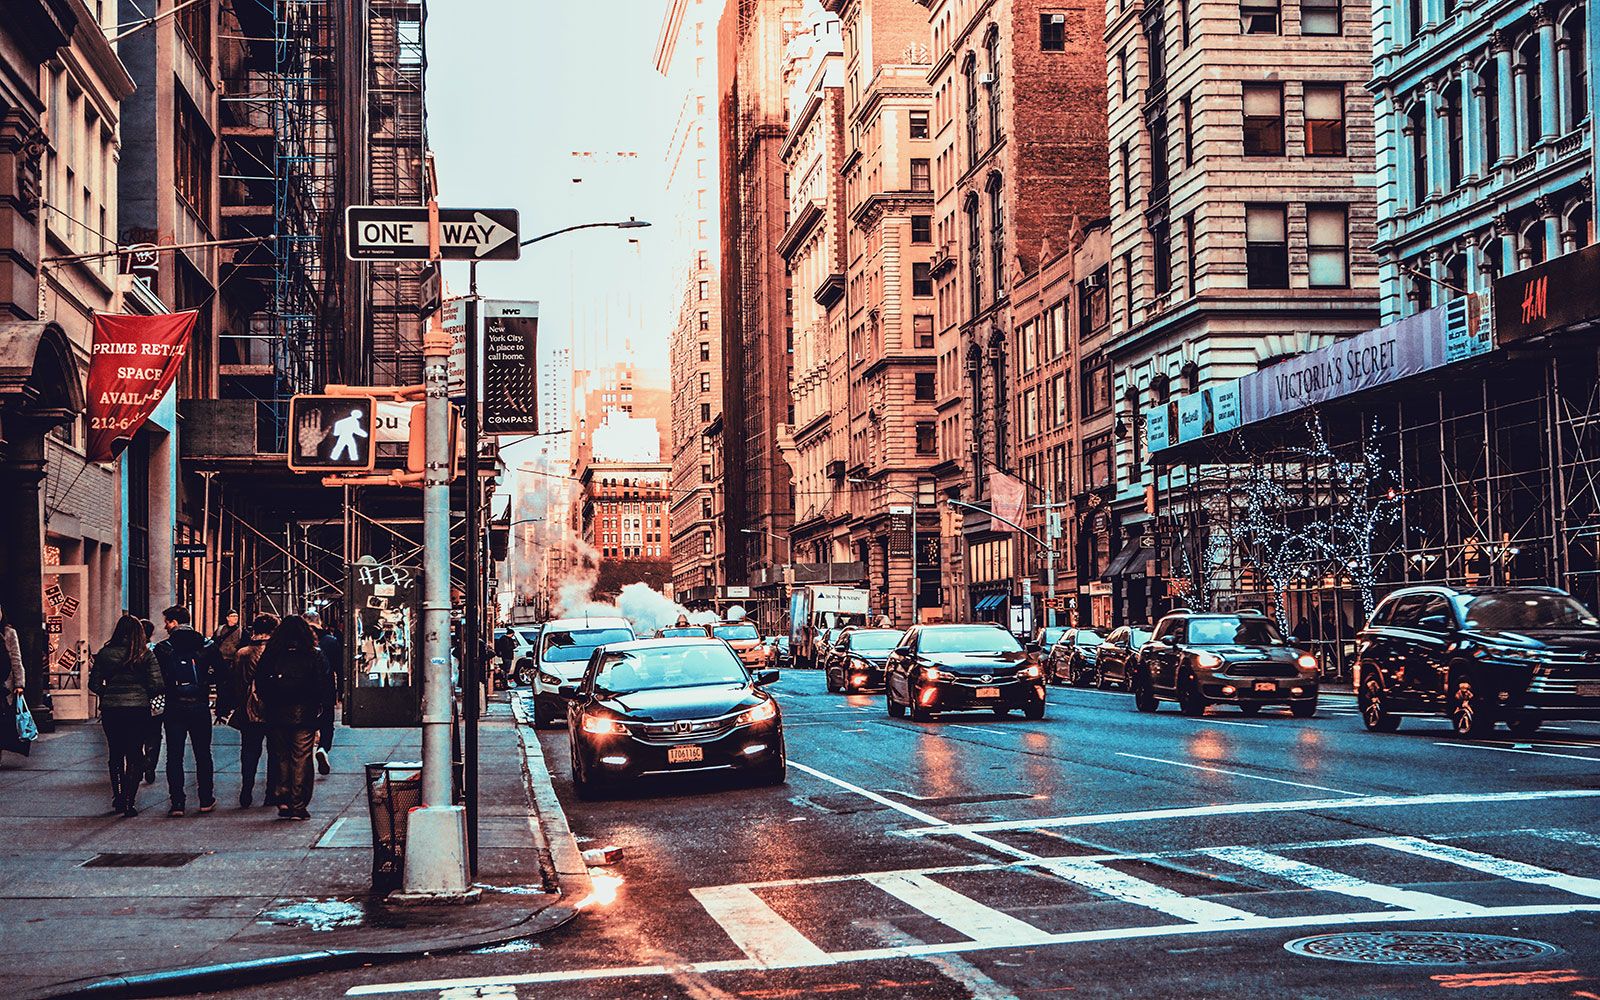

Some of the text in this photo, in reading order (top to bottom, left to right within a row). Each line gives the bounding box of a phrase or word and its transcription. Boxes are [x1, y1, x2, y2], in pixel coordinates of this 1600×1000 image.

[364, 224, 496, 244] ONE WAY
[1521, 275, 1548, 324] H&M
[506, 334, 524, 343] City.
[92, 343, 137, 355] PRIME
[496, 344, 515, 352] place
[117, 367, 163, 381] SPACE
[1276, 339, 1396, 401] VICTORIA'S SECRET
[375, 417, 398, 429] ou
[488, 416, 534, 424] COMPASS
[50, 624, 61, 632] $5
